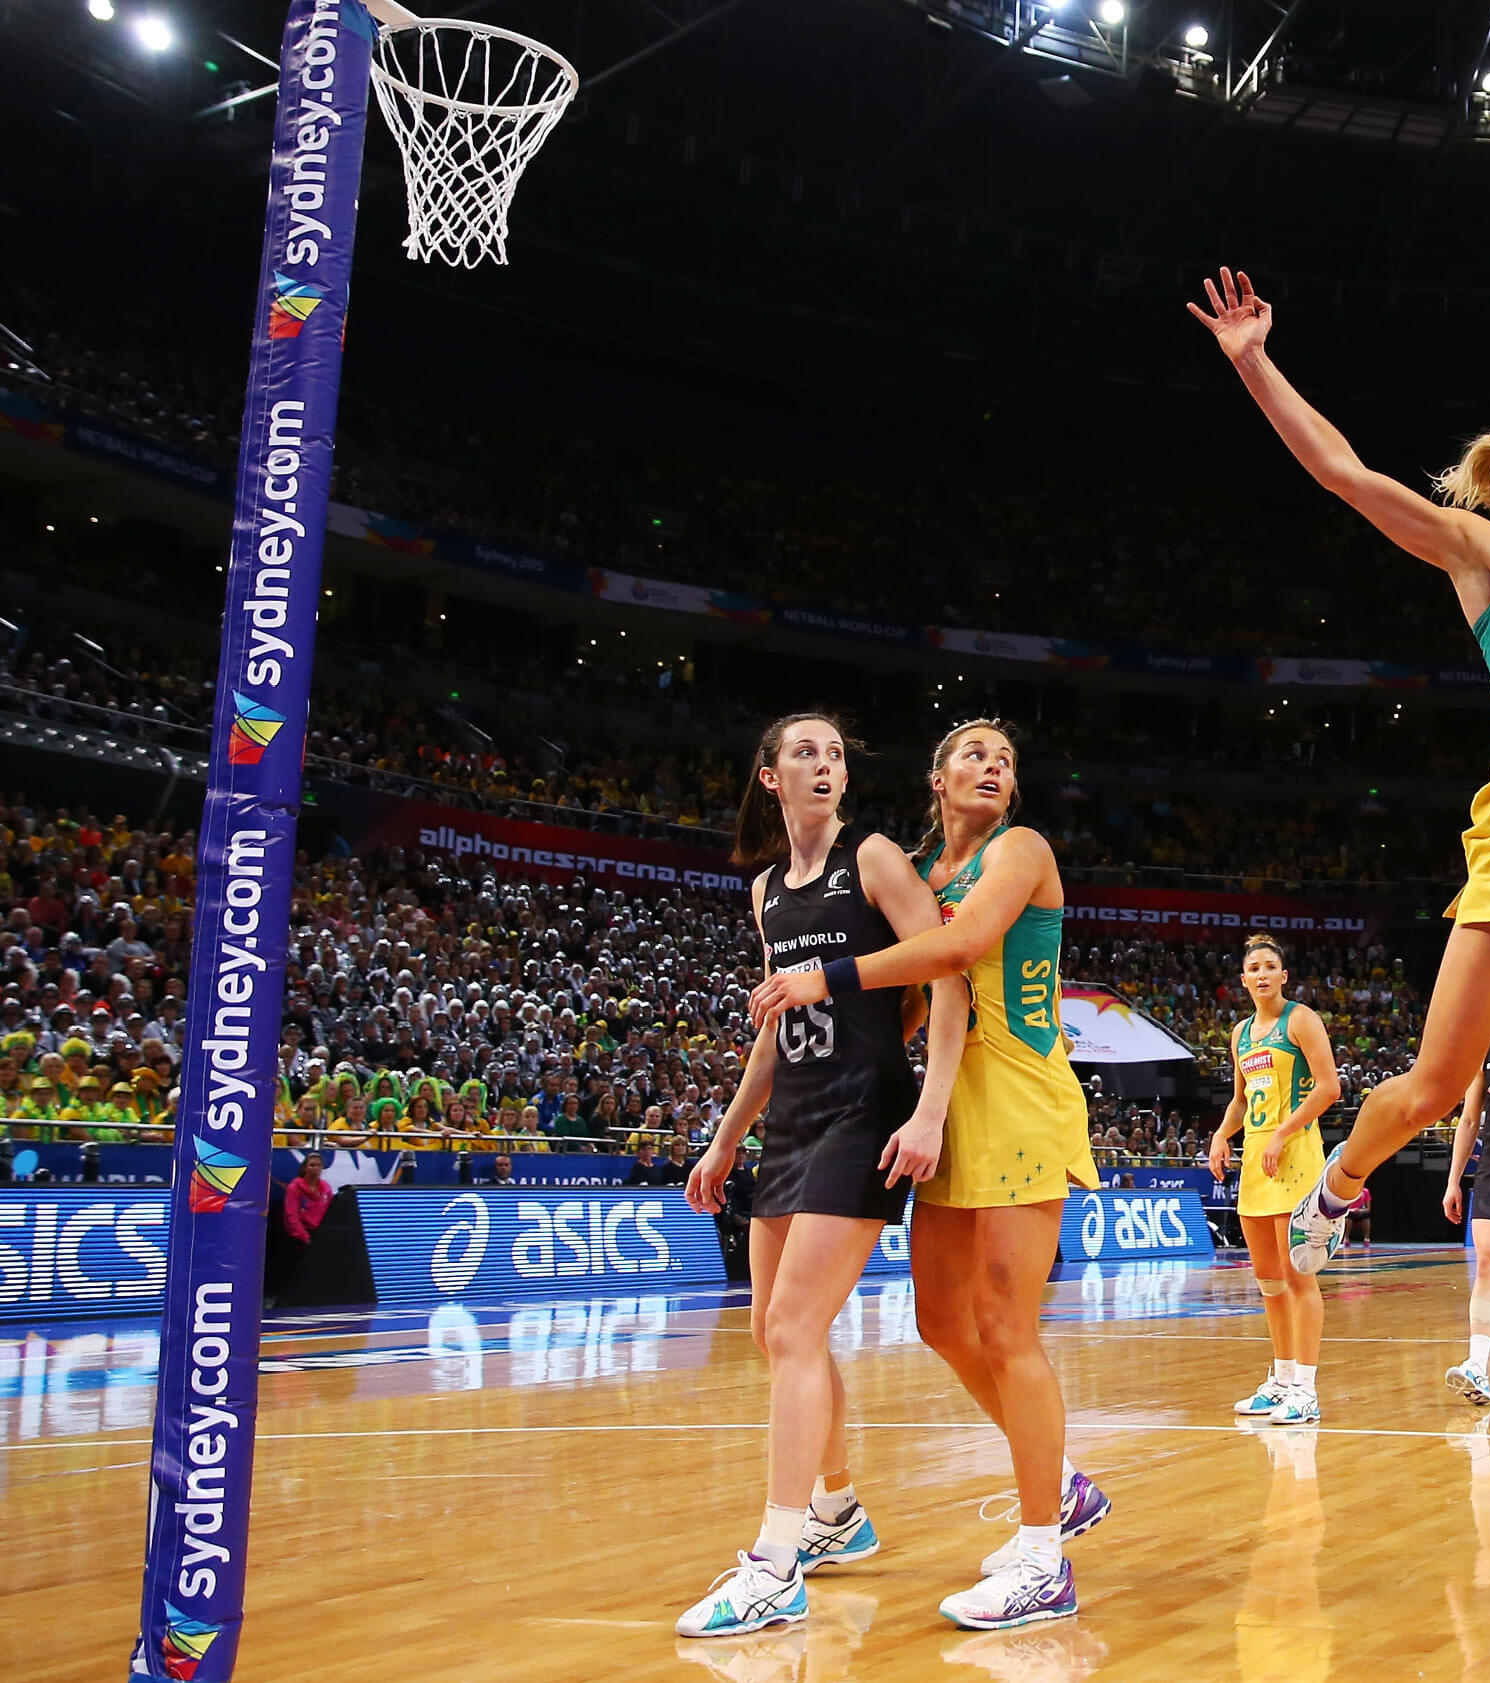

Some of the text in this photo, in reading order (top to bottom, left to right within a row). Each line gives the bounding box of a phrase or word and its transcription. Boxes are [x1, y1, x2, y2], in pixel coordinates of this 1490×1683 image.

[284, 0, 344, 266] sydney.com
[243, 400, 305, 687] sydney.com
[773, 931, 847, 955] NEW WORLD
[201, 829, 267, 1132] sydney.com
[1021, 959, 1052, 1029] AUS
[779, 996, 834, 1063] GS
[1241, 1054, 1272, 1070] CHEMIST
[1250, 1089, 1266, 1127] C
[512, 1201, 670, 1278] asics
[174, 1282, 239, 1600] sydney.com
